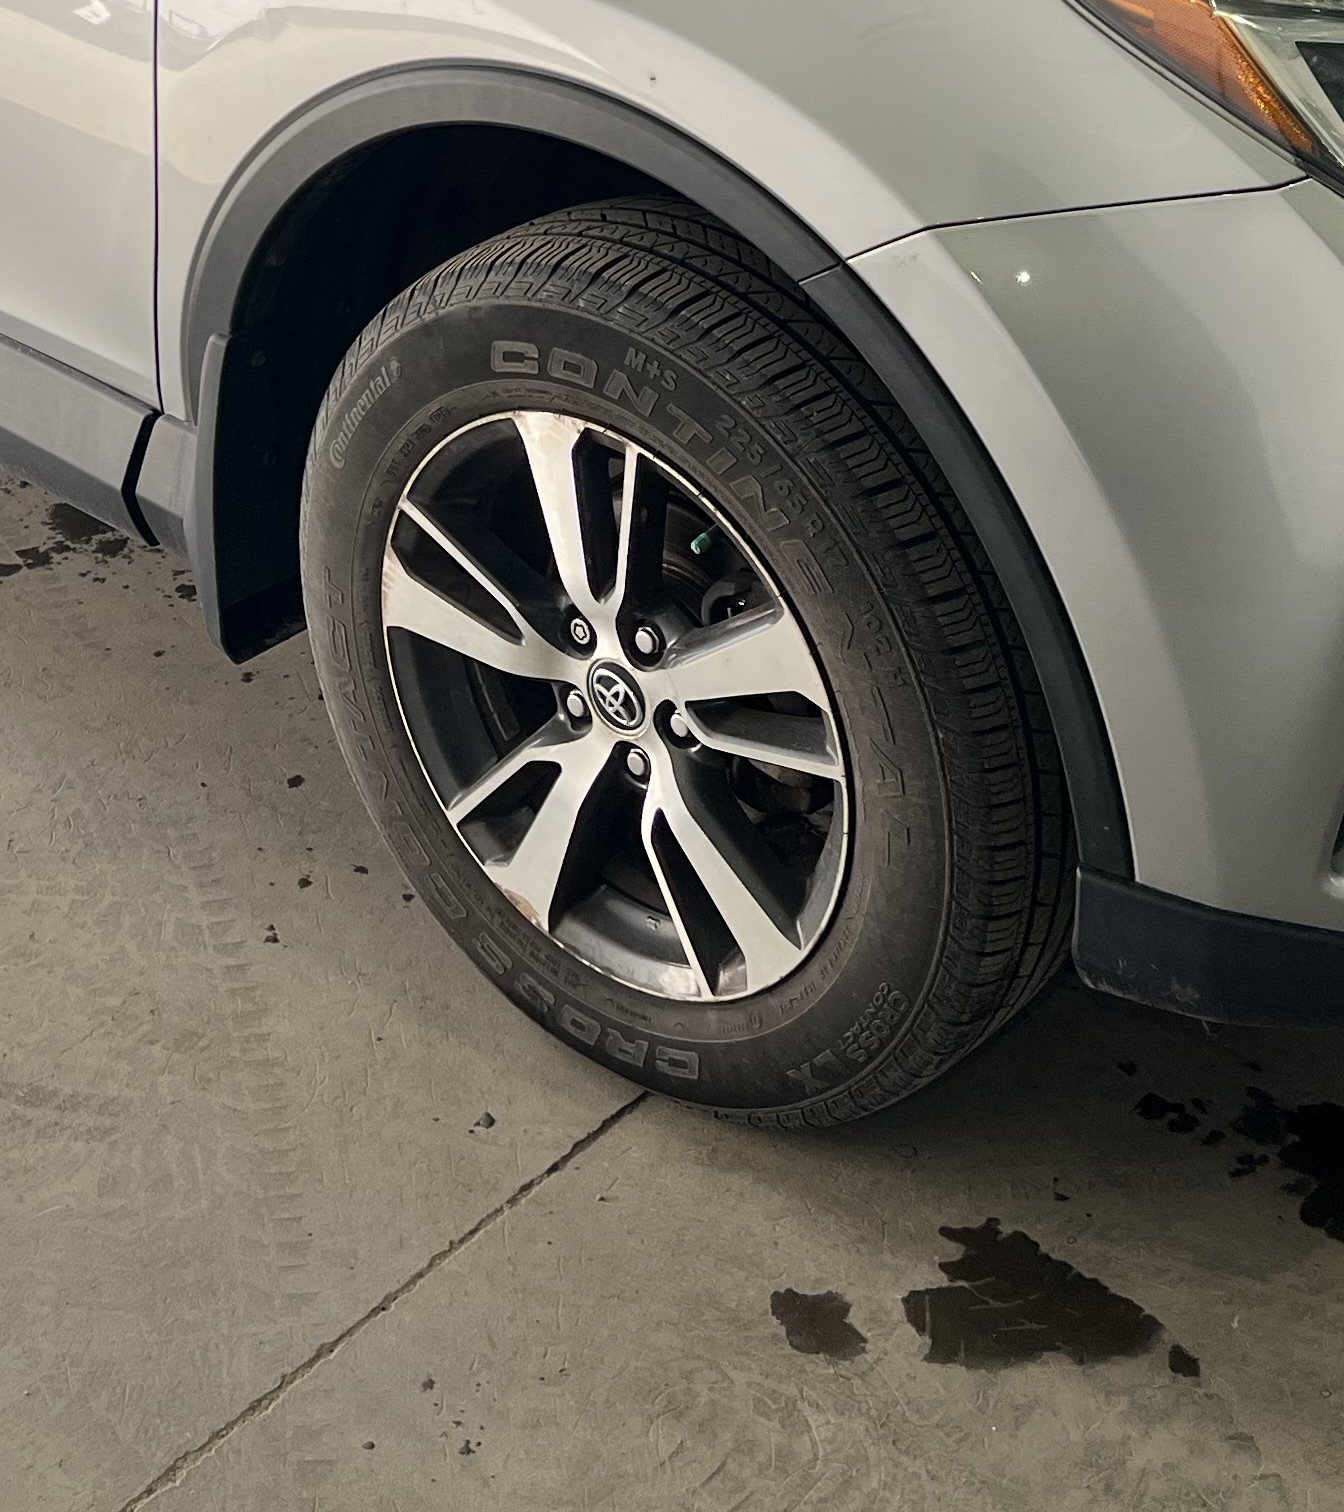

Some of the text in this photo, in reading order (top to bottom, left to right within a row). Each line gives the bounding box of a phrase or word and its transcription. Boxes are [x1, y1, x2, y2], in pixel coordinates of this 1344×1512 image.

[329, 365, 392, 469] Continental
[624, 347, 678, 391] M+S
[490, 340, 911, 870] CONTINENTAL
